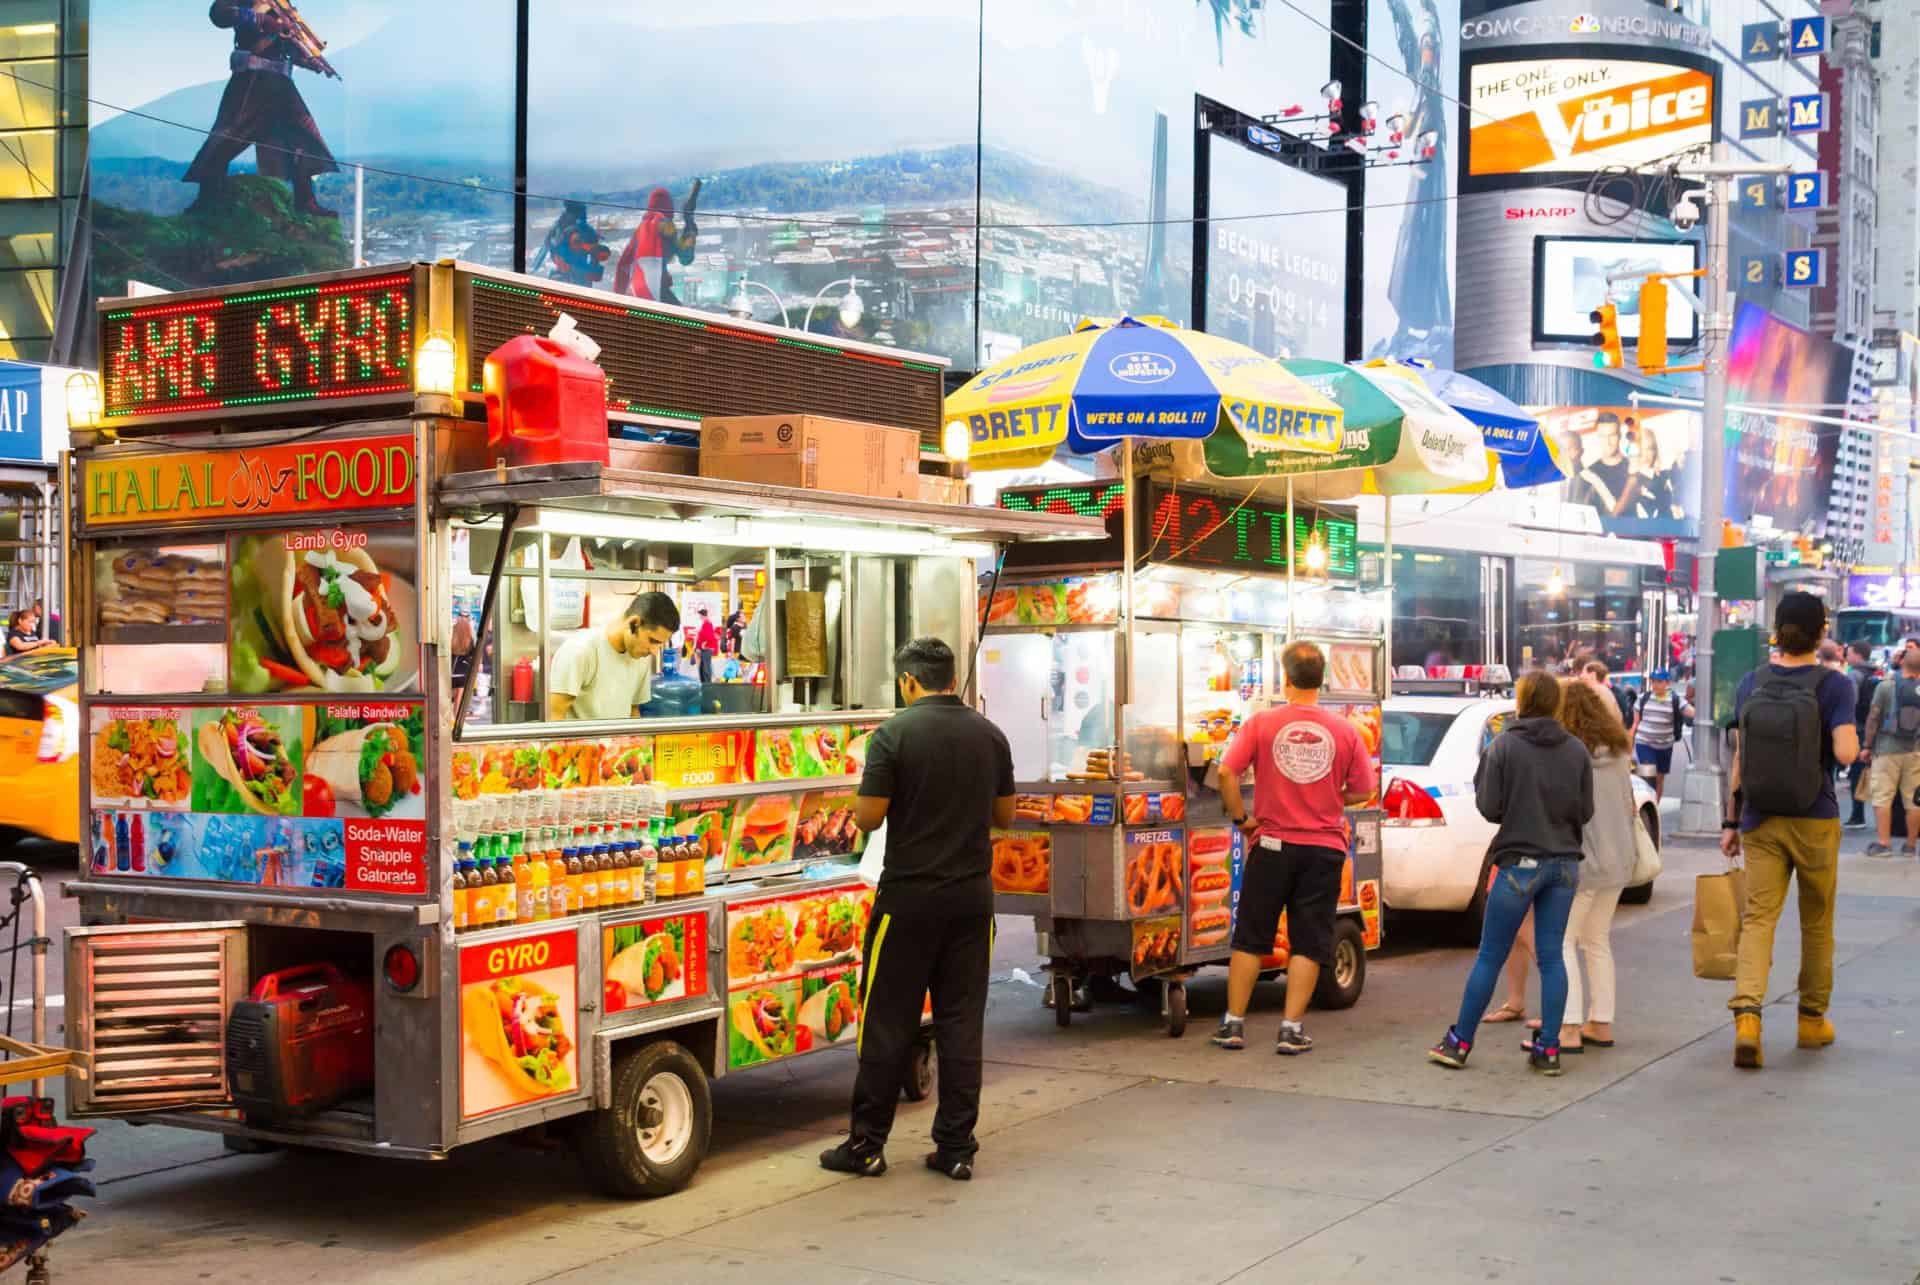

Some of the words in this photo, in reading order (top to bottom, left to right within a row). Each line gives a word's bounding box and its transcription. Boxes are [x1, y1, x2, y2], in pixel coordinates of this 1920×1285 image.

[1476, 79, 1513, 99] THE
[1515, 67, 1550, 87] ONE
[1524, 84, 1560, 101] THE
[1563, 67, 1612, 89] ONLY.
[1505, 207, 1576, 219] SHARP
[1218, 228, 1279, 267] BECOME
[1285, 251, 1338, 285] LEGEND
[1024, 302, 1077, 324] DESTINY
[1229, 272, 1328, 326] 09.09.14
[256, 292, 410, 389] GYRO
[968, 403, 1063, 442] BRETT
[1086, 411, 1124, 425] WE'RE
[1127, 412, 1144, 424] ON
[1146, 412, 1155, 424] A
[1158, 411, 1188, 424] ROLL
[1230, 402, 1337, 441] SABRETT
[1492, 427, 1514, 440] ROLL
[90, 462, 224, 516] HALAL
[295, 446, 414, 501] FOOD
[286, 531, 326, 550] Lamb
[331, 531, 368, 552] Gyro
[327, 706, 360, 719] Falafel
[362, 706, 409, 719] Sandwich
[682, 771, 715, 784] FOOD
[348, 825, 423, 843] Soda-Water
[1134, 831, 1173, 844] PRETZEL
[360, 846, 413, 867] Snapple
[1233, 832, 1241, 875] HOT
[357, 867, 417, 885] Gatorade
[488, 940, 549, 974] GYRO
[689, 918, 697, 991] FALAFEL
